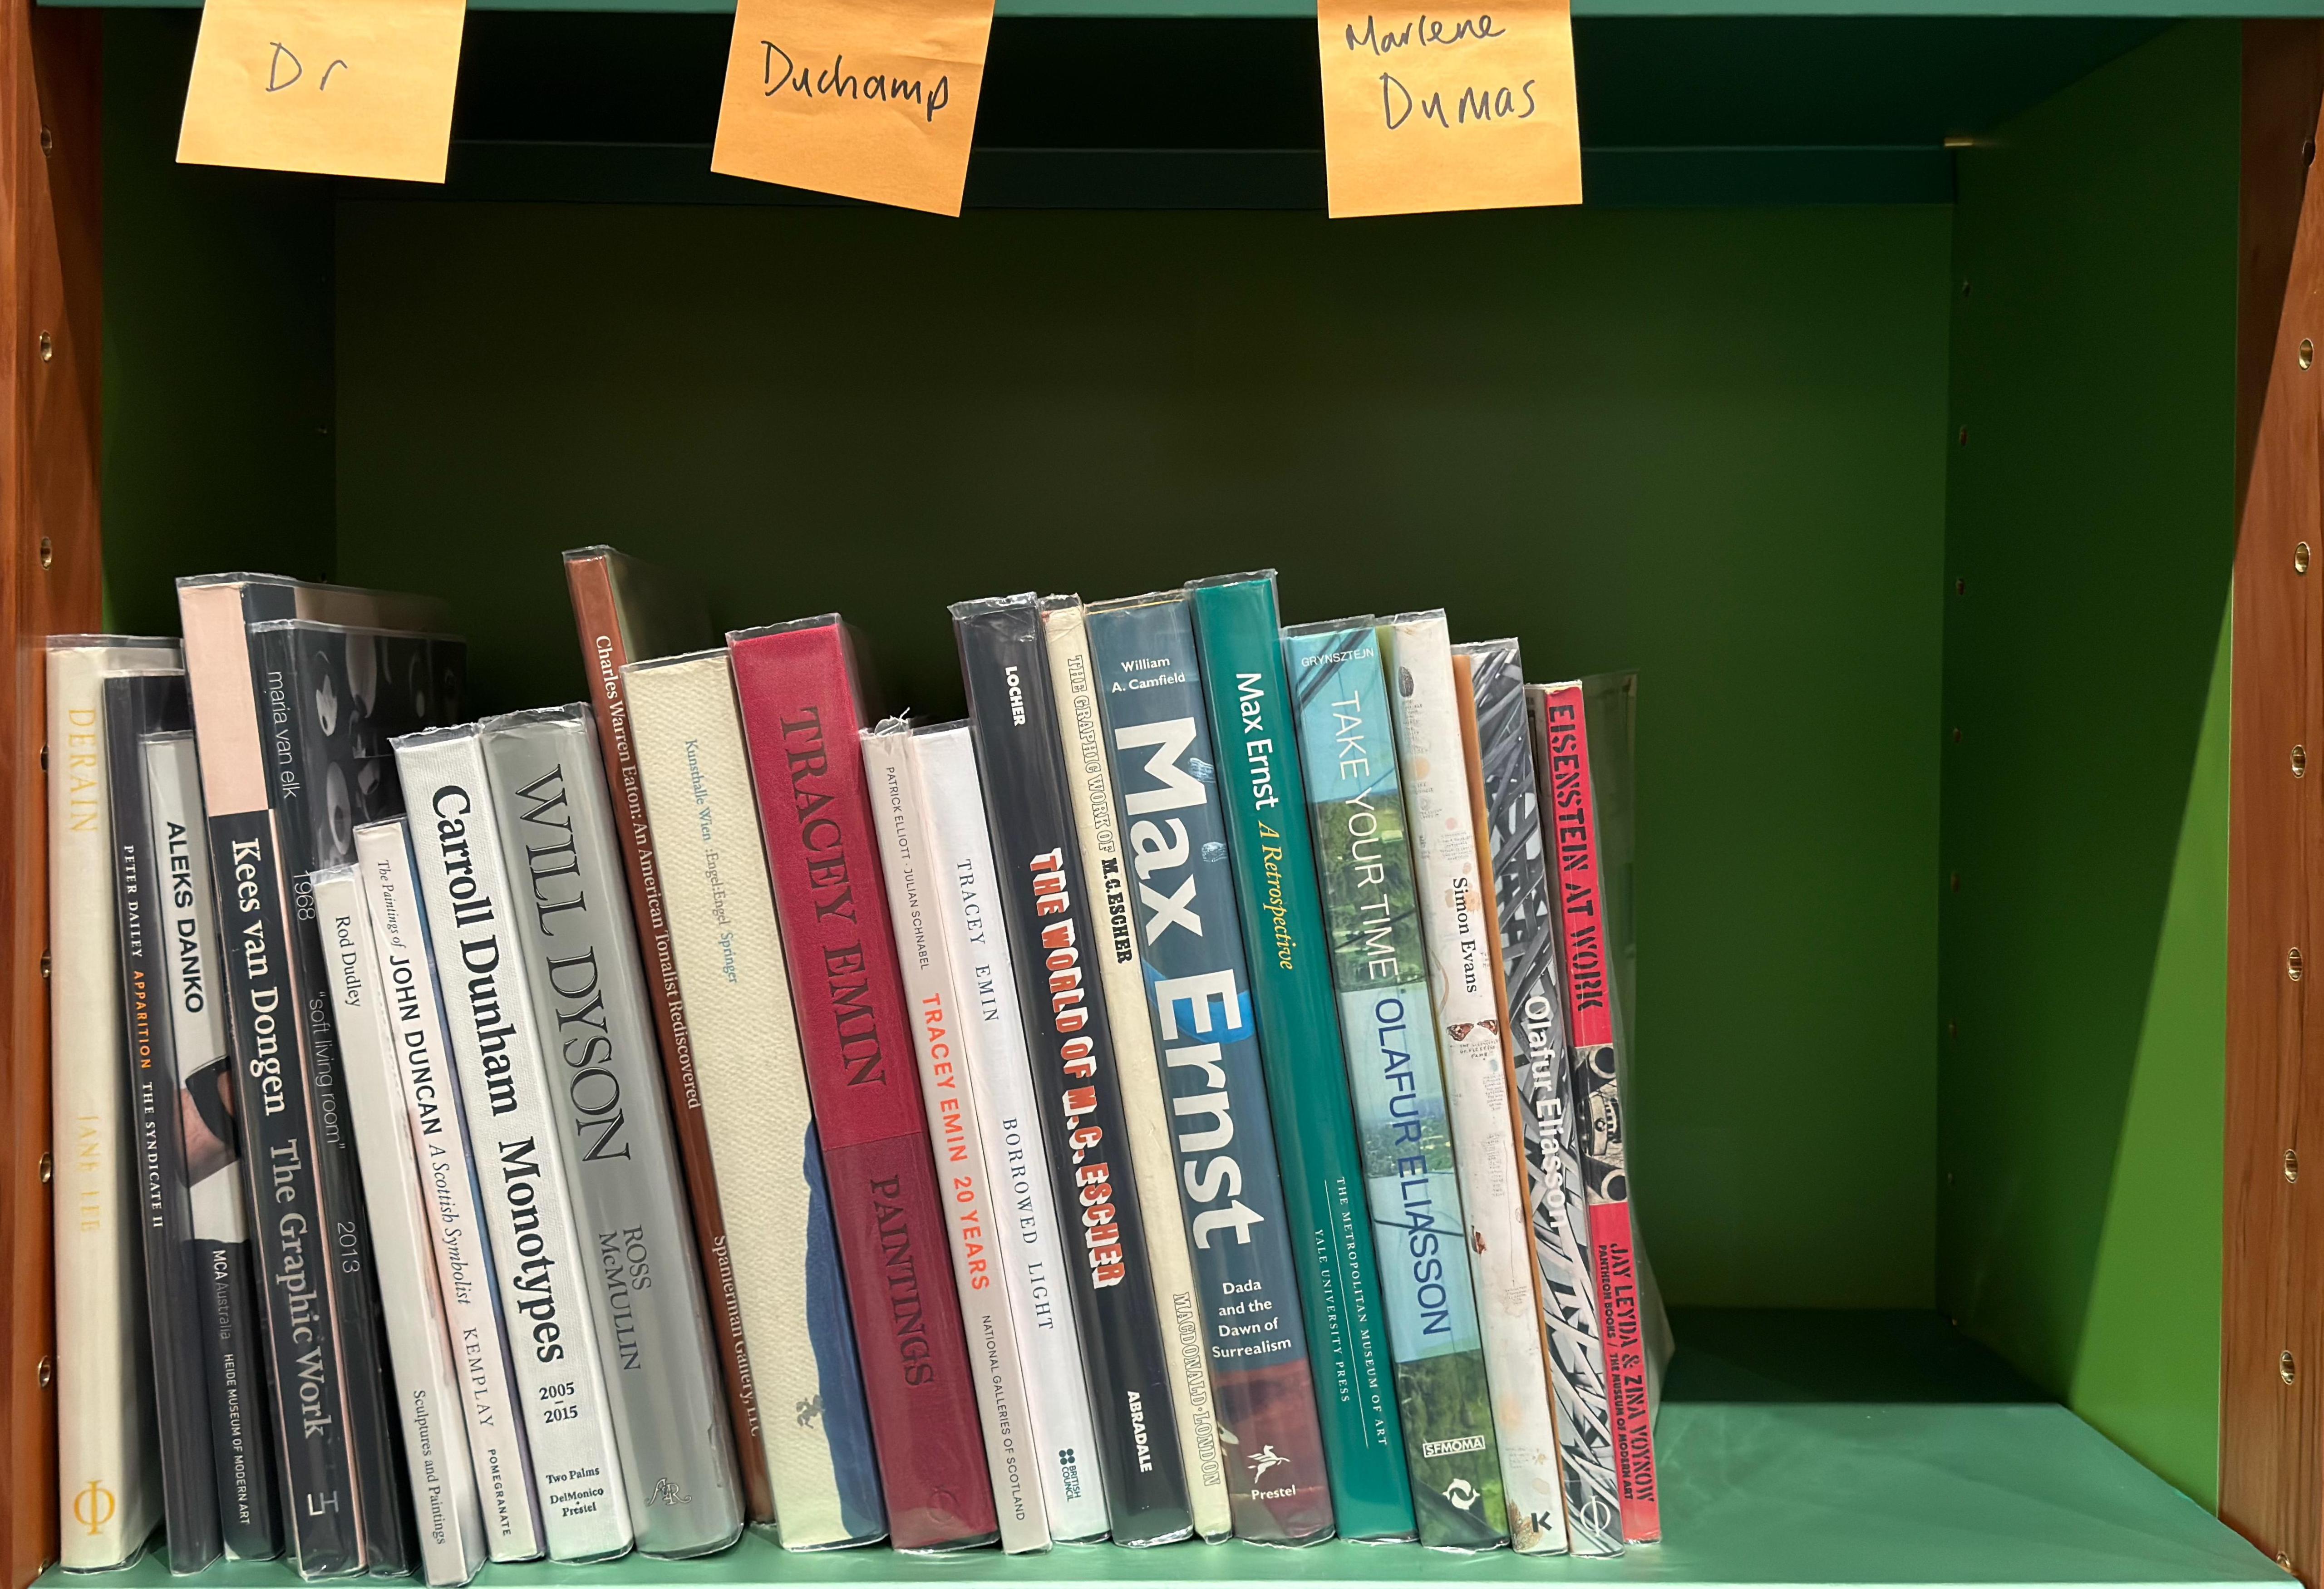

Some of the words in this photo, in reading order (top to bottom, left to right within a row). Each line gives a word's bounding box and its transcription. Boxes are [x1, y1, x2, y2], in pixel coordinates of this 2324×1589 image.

[1345, 15, 1506, 56] Marlene
[266, 42, 348, 92] Dr
[761, 40, 949, 123] Duchamp
[1379, 72, 1535, 130] Dumas
[596, 635, 618, 699] Charles
[1068, 654, 1087, 693] THE
[1111, 682, 1126, 693] A.
[1128, 672, 1186, 691] Camfield
[1121, 657, 1170, 673] William
[1301, 647, 1374, 667] GRYNSZTEJN
[267, 671, 288, 725] maria
[1005, 666, 1026, 726] LOCHER
[1236, 673, 1264, 734] Max
[275, 729, 293, 765] van
[609, 700, 630, 762] Warren
[1073, 695, 1101, 773] GRAPHIC
[1331, 690, 1370, 780] TAKE
[68, 709, 98, 832] DERAIN
[281, 772, 301, 799] elk
[621, 764, 642, 819] Eaton:
[685, 738, 704, 805] Kunsthalle
[699, 807, 713, 841] Wien
[1247, 738, 1279, 811] Ernst
[1549, 704, 1588, 871] EISENSTEIN
[1088, 774, 1110, 829] WORK
[1259, 820, 1280, 838] A
[432, 785, 494, 929] Carroll
[515, 763, 586, 936] WILL
[633, 822, 647, 847] An
[1097, 830, 1115, 853] OF
[1115, 717, 1207, 947] Max
[1345, 787, 1384, 888] YOUR
[124, 845, 138, 895] PETER
[167, 821, 193, 908] ALEKS
[232, 838, 261, 912] Kees
[377, 860, 390, 882] The
[638, 847, 663, 929] American
[886, 767, 902, 813] PATRICK
[894, 815, 910, 860] ELLIOTT
[903, 868, 919, 908] JULIAN
[911, 911, 930, 970] SCHNABEL
[1029, 847, 1070, 917] THE
[293, 871, 316, 920] 1968
[381, 883, 399, 936] Paintings
[779, 706, 857, 925] TRACEY
[823, 940, 887, 1086] EMIN
[1261, 844, 1294, 970] Retrospective
[1453, 877, 1471, 935] Simon
[1565, 882, 1594, 916] AT
[127, 900, 143, 957] DAILEY
[243, 920, 269, 979] van
[335, 915, 352, 948] Rod
[957, 859, 986, 945] TRACEY
[975, 964, 999, 1022] EMIN
[1360, 894, 1399, 982] TIME
[177, 918, 204, 1013] DANKO
[342, 951, 362, 1008] Dudley
[655, 930, 679, 992] Tonalist
[720, 932, 738, 984] Springer
[1041, 918, 1088, 1033] WORLD
[1461, 939, 1477, 994] Evans
[1571, 925, 1604, 1012] WORK
[390, 955, 420, 1021] JOHN
[133, 970, 151, 1069] APPARITION
[460, 934, 517, 1117] Dunham
[922, 993, 955, 1089] TRACEY
[1524, 996, 1556, 1097] Olafur
[250, 986, 286, 1117] Dongen
[315, 1041, 334, 1087] living
[546, 945, 631, 1162] DYSON
[668, 994, 701, 1110] Rediscovered
[1060, 1036, 1097, 1079] OF
[1375, 998, 1423, 1146] OLAFUR
[142, 1082, 155, 1115] THE
[404, 1030, 442, 1136] DUNCAN
[1154, 969, 1264, 1249] Ernst
[429, 1143, 446, 1157] A
[940, 1098, 969, 1163] EMIN
[145, 1121, 162, 1210] SYNDICATE
[270, 1138, 302, 1204] The
[954, 1176, 975, 1203] 20
[1337, 1176, 1349, 1206] THE
[1536, 1098, 1568, 1228] Eliasson
[153, 1215, 163, 1228] II
[433, 1162, 453, 1223] Scottish
[337, 1221, 360, 1274] 2013
[498, 1136, 564, 1363] Monotypes
[960, 1209, 990, 1291] YEARS
[1003, 1117, 1038, 1244] BORROWED
[1028, 1261, 1054, 1330] LIGHT
[1315, 1229, 1328, 1263] YALE
[1397, 1155, 1451, 1335] ELIASSON
[212, 1249, 227, 1281] MCA
[276, 1212, 320, 1345] Graphic
[443, 1228, 472, 1305] Symbolist
[623, 1224, 651, 1291] ROSS
[870, 1174, 935, 1387] PAINTINGS
[1222, 1279, 1262, 1294] Dada
[1341, 1211, 1368, 1323] METROPOLITAN
[1599, 1244, 1613, 1299] PANTHEON
[1610, 1242, 1632, 1278] JAY
[215, 1282, 232, 1340] Australia
[598, 1229, 641, 1371] McMULLIN
[1218, 1302, 1245, 1316] and
[1248, 1300, 1272, 1313] the
[1218, 1322, 1261, 1337] Dawn
[1264, 1317, 1279, 1331] of
[1321, 1269, 1343, 1355] UNIVERSITY
[1605, 1301, 1616, 1339] BOOKS
[1615, 1285, 1638, 1348] LEYDA
[224, 1353, 237, 1388] HEIDE
[982, 1315, 1000, 1373] NATIONAL
[1212, 1338, 1292, 1358] Surrealism
[1360, 1329, 1378, 1388] MUSEUM
[1610, 1353, 1620, 1372] THE
[1622, 1353, 1640, 1368] &
[295, 1346, 332, 1439] Work
[463, 1326, 494, 1427] KEMPLAY
[539, 1382, 575, 1401] 2005
[993, 1375, 1011, 1435] GALLERIES
[1336, 1361, 1350, 1402] PRESS
[1371, 1394, 1383, 1412] OF
[1611, 1373, 1625, 1417] MUSEUM
[1624, 1375, 1646, 1420] ZINA
[227, 1389, 241, 1436] MUSEUM
[414, 1390, 432, 1457] Sculptures
[544, 1405, 578, 1423] 2015
[1127, 1390, 1153, 1473] ABRADALE
[1375, 1418, 1387, 1446] ART
[232, 1438, 243, 1452] OF
[424, 1460, 439, 1483] and
[1004, 1438, 1015, 1456] OF
[1425, 1437, 1484, 1456] SFMOMA
[1617, 1434, 1631, 1485] MODERN
[1630, 1424, 1655, 1502] VOYNOW
[234, 1455, 247, 1502] MODERN
[488, 1448, 511, 1536] POMEGRANATE
[546, 1472, 567, 1485] Two
[569, 1467, 600, 1481] Palms
[550, 1487, 604, 1505] DelMonico
[1006, 1456, 1025, 1521] SCOTLAND
[1062, 1466, 1073, 1503] COUNCIL
[1069, 1465, 1081, 1498] BRITISH
[1251, 1485, 1296, 1500] Prestel
[1623, 1485, 1634, 1500] ART
[239, 1503, 250, 1525] ART
[427, 1485, 445, 1545] Paintings
[562, 1501, 597, 1518] Prestel
[1531, 1511, 1552, 1533] K
